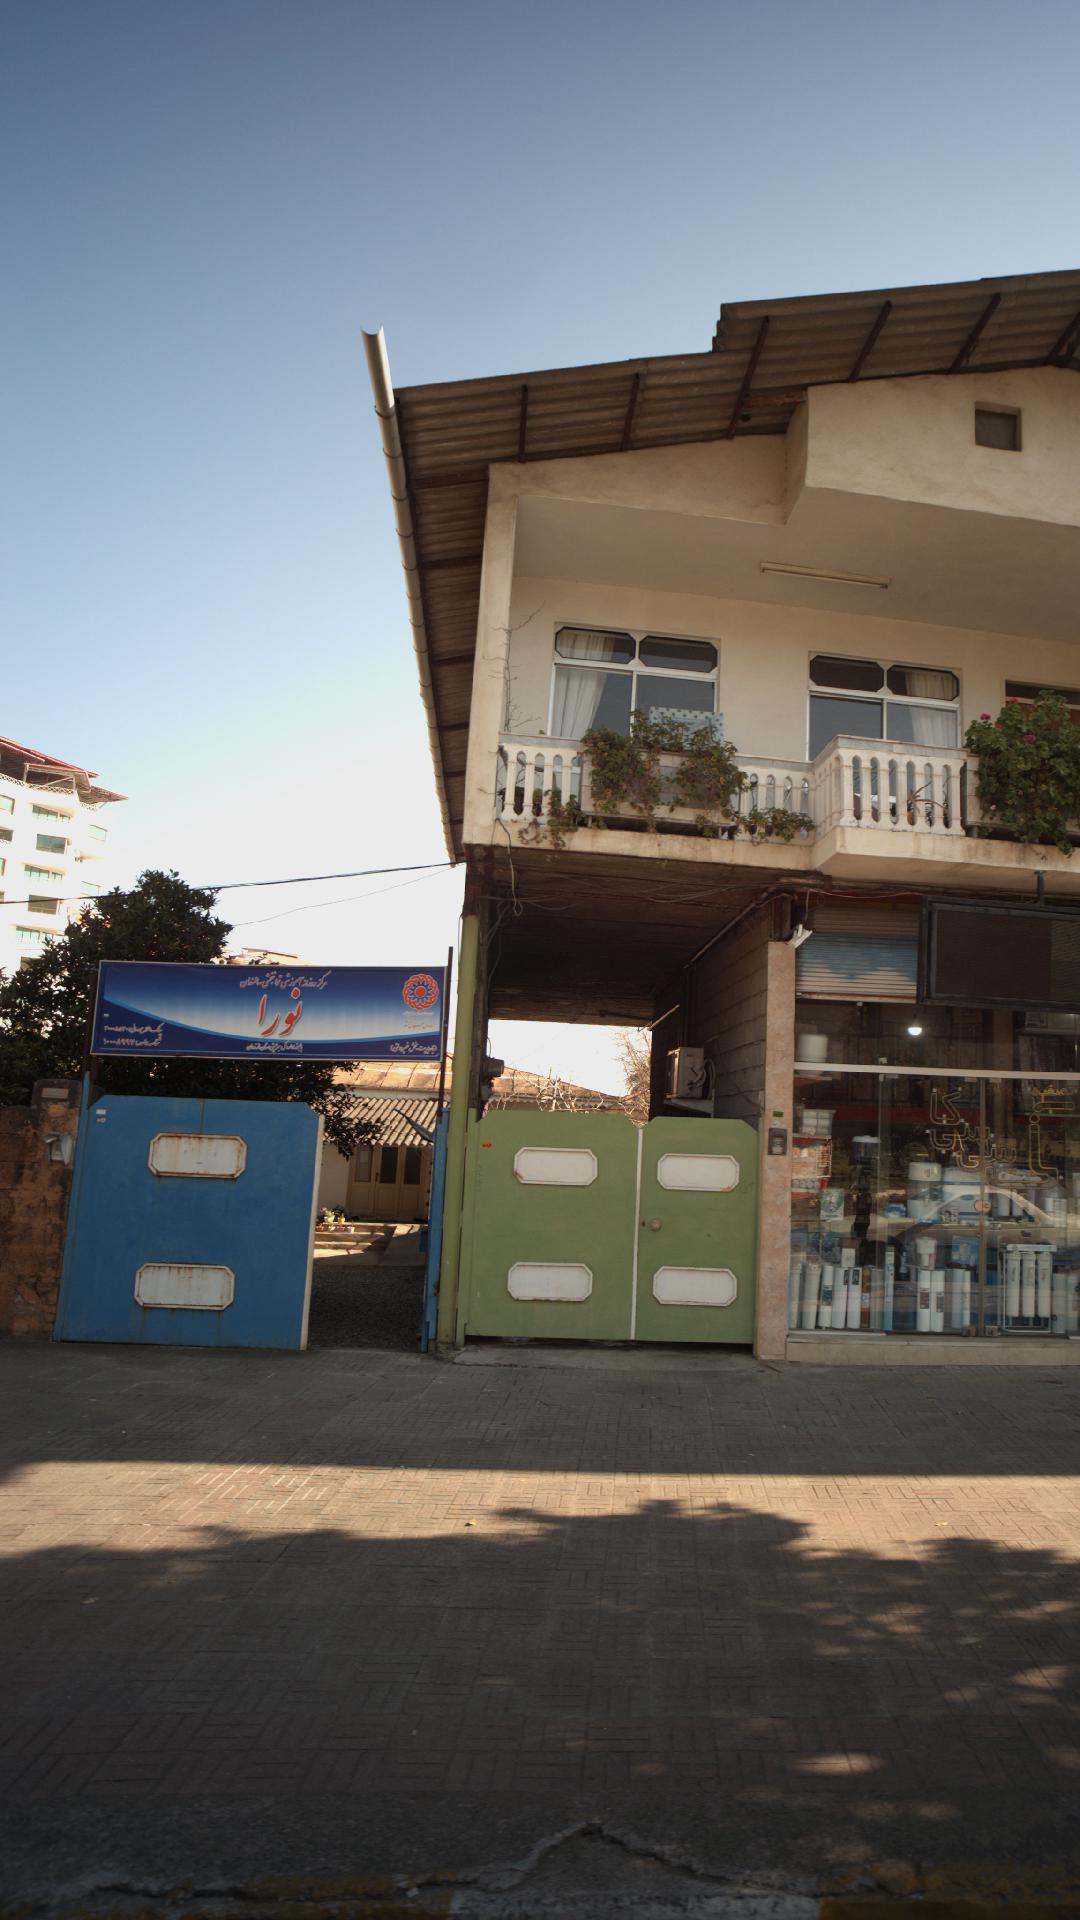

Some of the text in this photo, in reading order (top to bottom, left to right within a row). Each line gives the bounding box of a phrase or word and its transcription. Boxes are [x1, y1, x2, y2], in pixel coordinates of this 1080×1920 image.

[316, 969, 332, 990] مرکز
[257, 986, 303, 1037] نورا
[930, 1088, 962, 1126] کا
